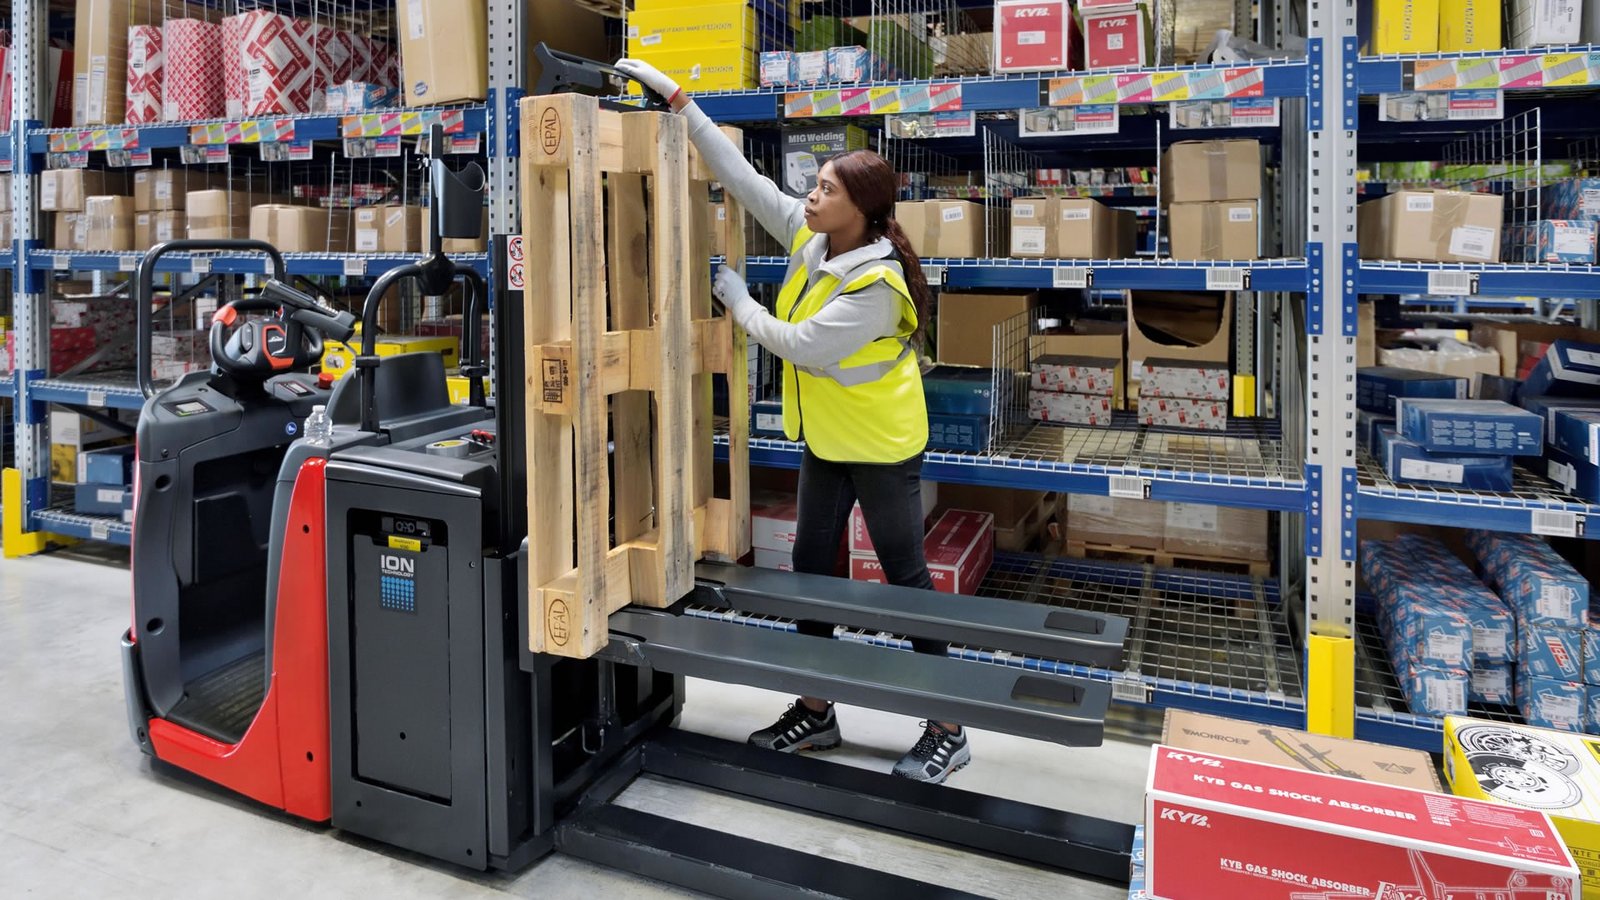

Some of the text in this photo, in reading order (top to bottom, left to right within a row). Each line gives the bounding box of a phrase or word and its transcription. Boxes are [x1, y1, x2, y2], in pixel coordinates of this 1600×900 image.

[1014, 7, 1049, 18] KYB
[1098, 18, 1127, 28] KYB
[545, 114, 557, 147] EPAL
[788, 132, 845, 143] MIG Welding
[381, 554, 414, 573] ION
[381, 569, 414, 578] TECHNOLOGY
[553, 606, 566, 640] EPAL
[1190, 731, 1243, 744] MONROE
[1167, 751, 1222, 768] KYB
[1193, 774, 1225, 786] KYB
[1230, 781, 1263, 793] GAS
[1269, 788, 1323, 804] SHOCK
[1328, 799, 1417, 821] ABSORBER
[1160, 807, 1209, 828] KYB
[1220, 857, 1242, 870] KYB
[1245, 863, 1268, 874] GAS
[1271, 868, 1308, 883] SHOCK
[1311, 877, 1370, 896] ABSORBER
